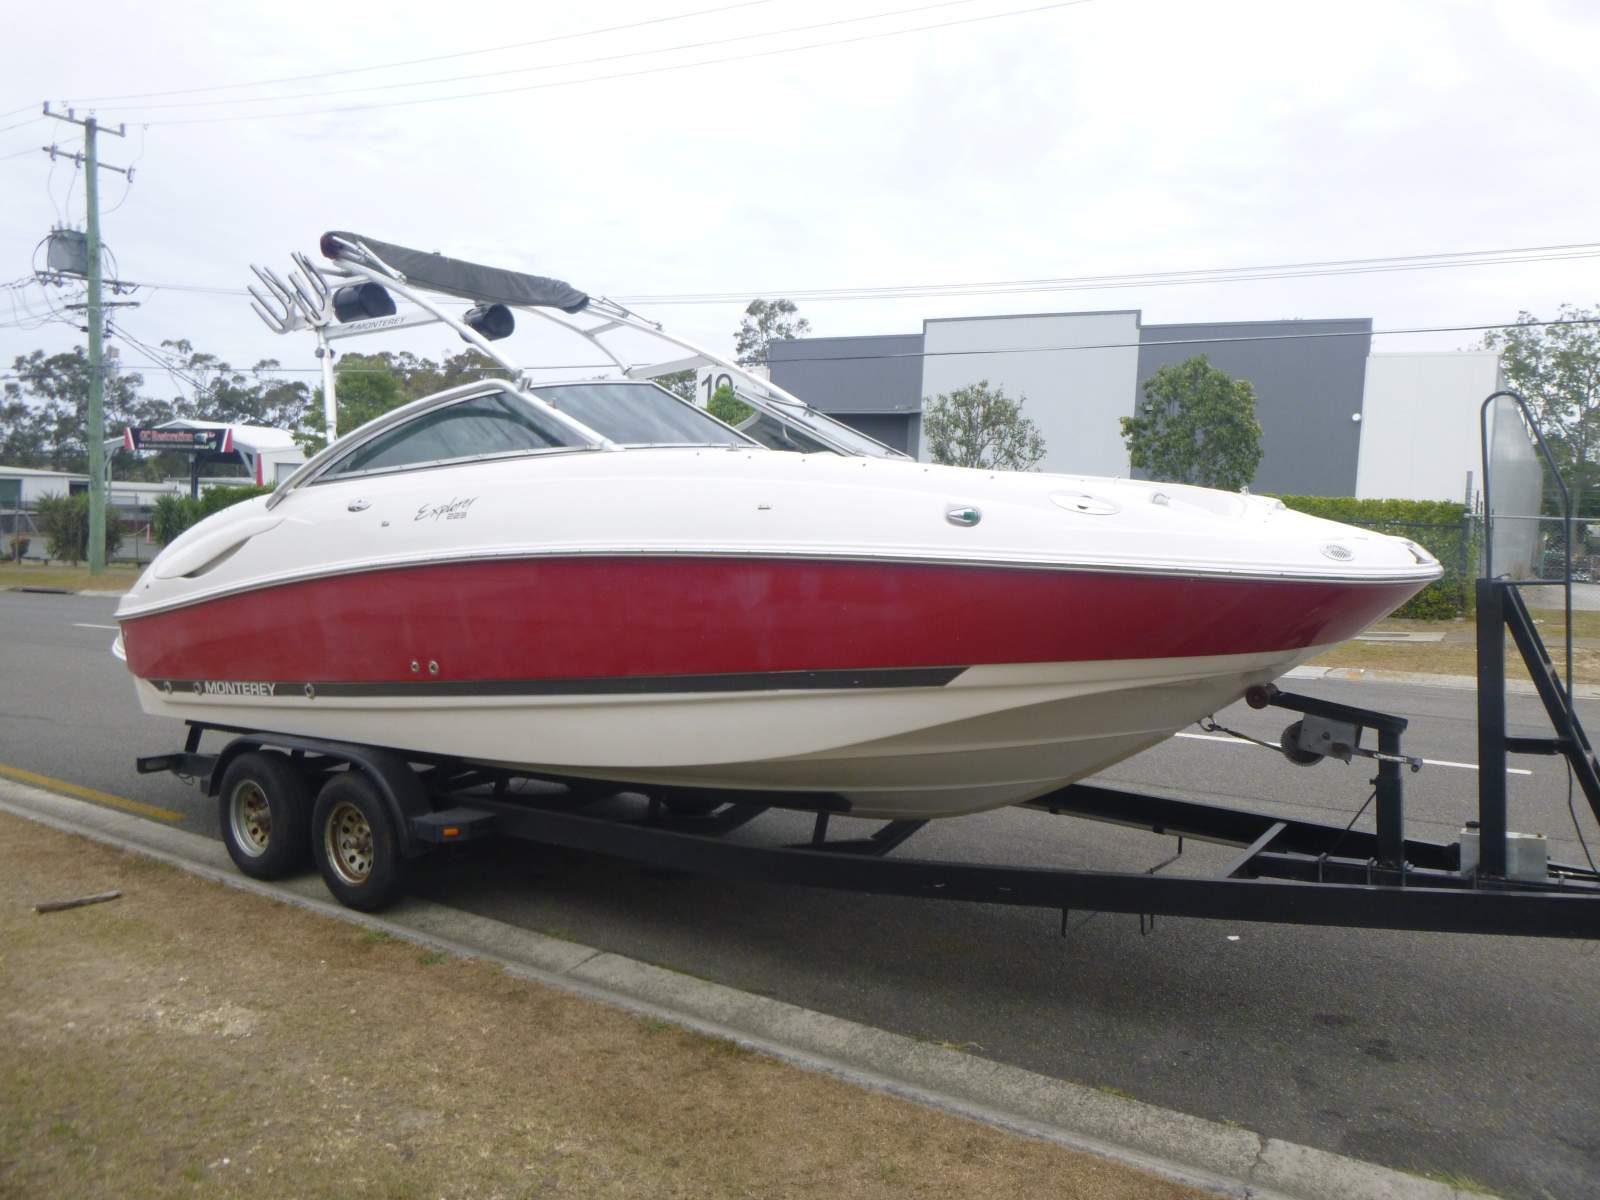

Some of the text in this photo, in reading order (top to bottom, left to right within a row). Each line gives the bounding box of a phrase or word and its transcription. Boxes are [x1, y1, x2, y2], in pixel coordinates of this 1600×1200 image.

[355, 316, 407, 330] MONTEREY
[414, 496, 479, 521] Explorer
[204, 681, 275, 696] MONTEREY
